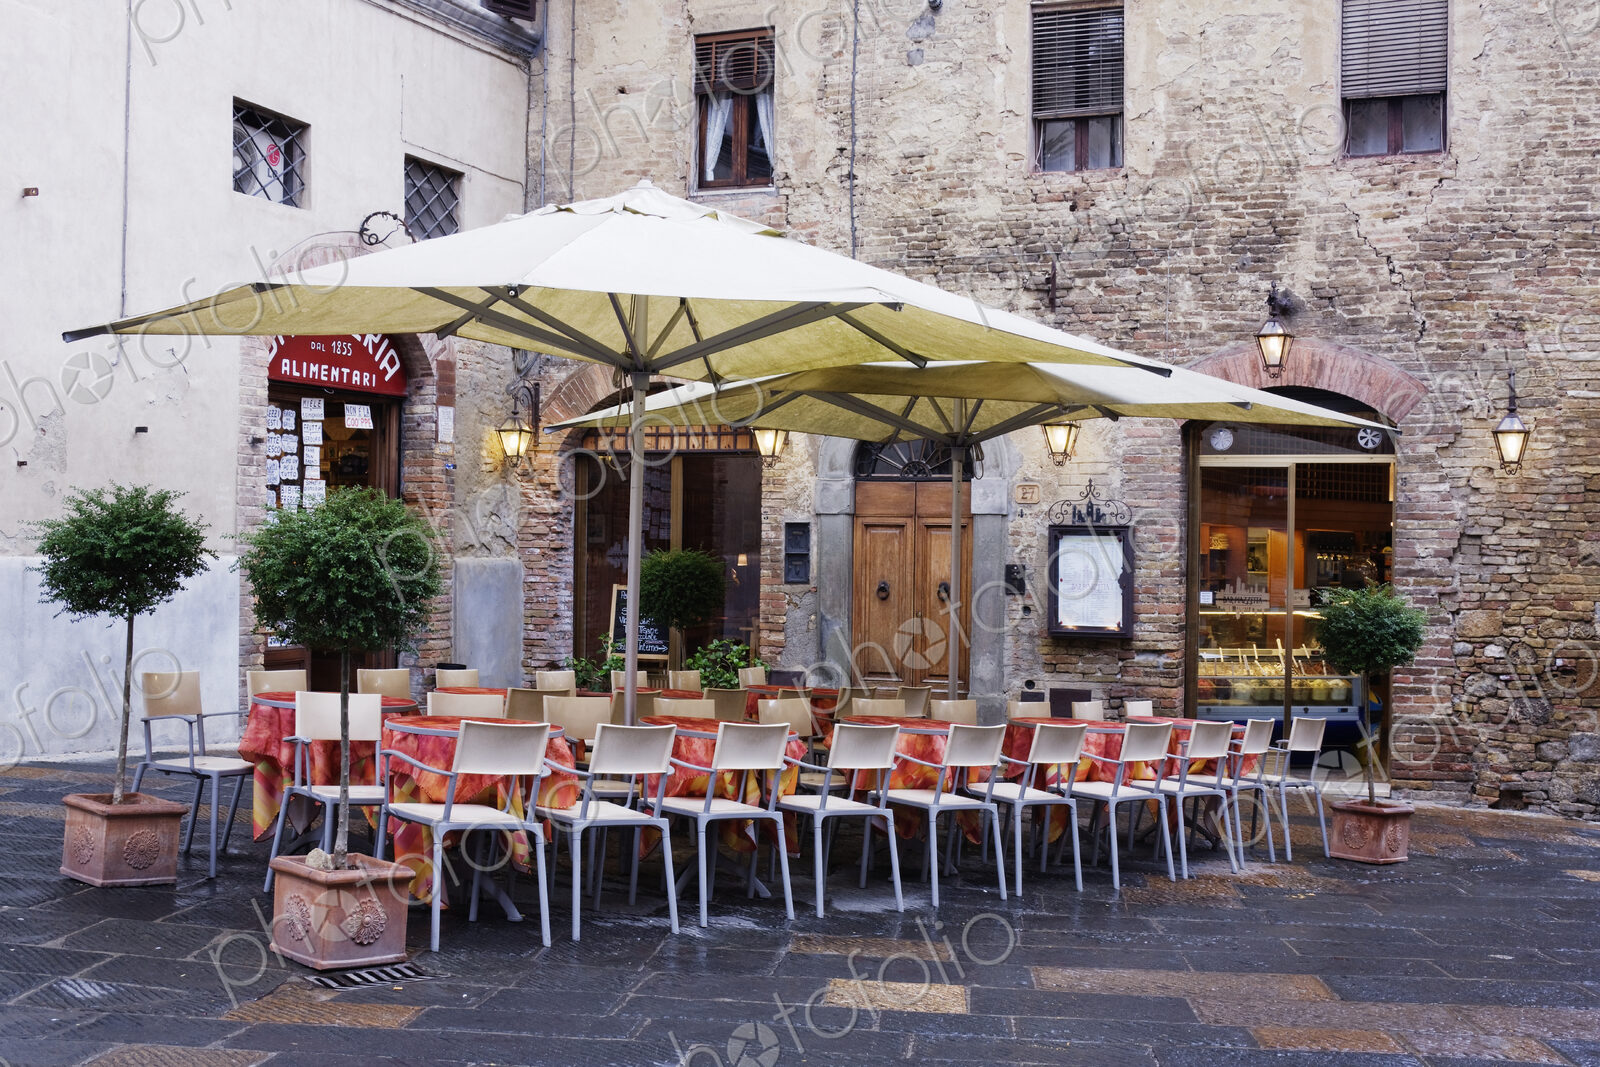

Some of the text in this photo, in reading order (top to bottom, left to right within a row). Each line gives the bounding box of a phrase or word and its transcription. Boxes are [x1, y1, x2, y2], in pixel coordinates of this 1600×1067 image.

[310, 340, 353, 356] DAL 1855
[281, 358, 376, 388] ALIMENTARI
[346, 405, 357, 415] NON
[1021, 487, 1036, 500] 27
